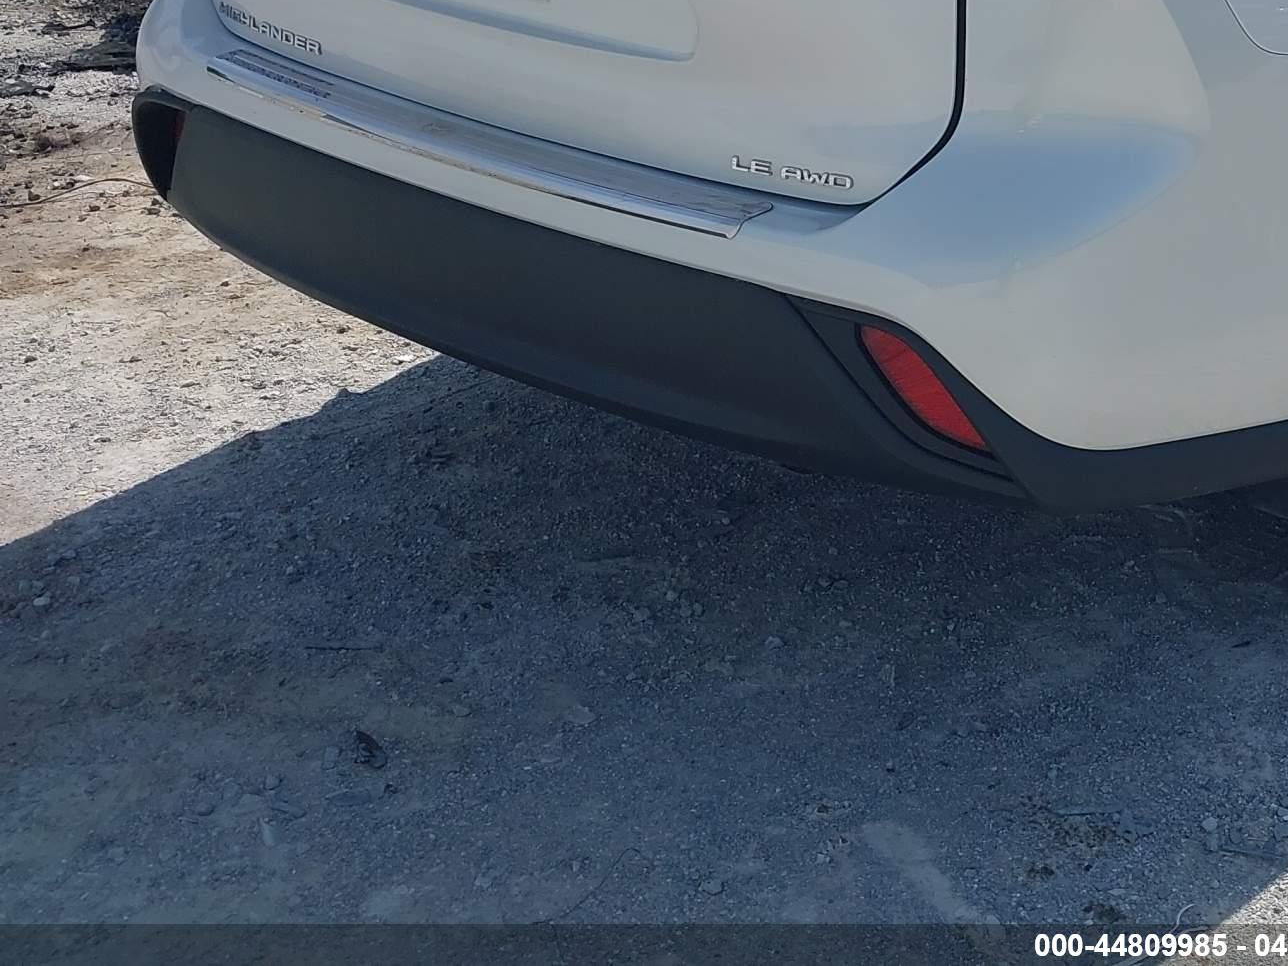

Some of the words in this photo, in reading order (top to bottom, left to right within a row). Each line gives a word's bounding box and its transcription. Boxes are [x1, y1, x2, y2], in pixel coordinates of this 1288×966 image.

[219, 0, 323, 56] HIGHLANDER
[731, 155, 773, 176] LE
[781, 166, 854, 190] AWD
